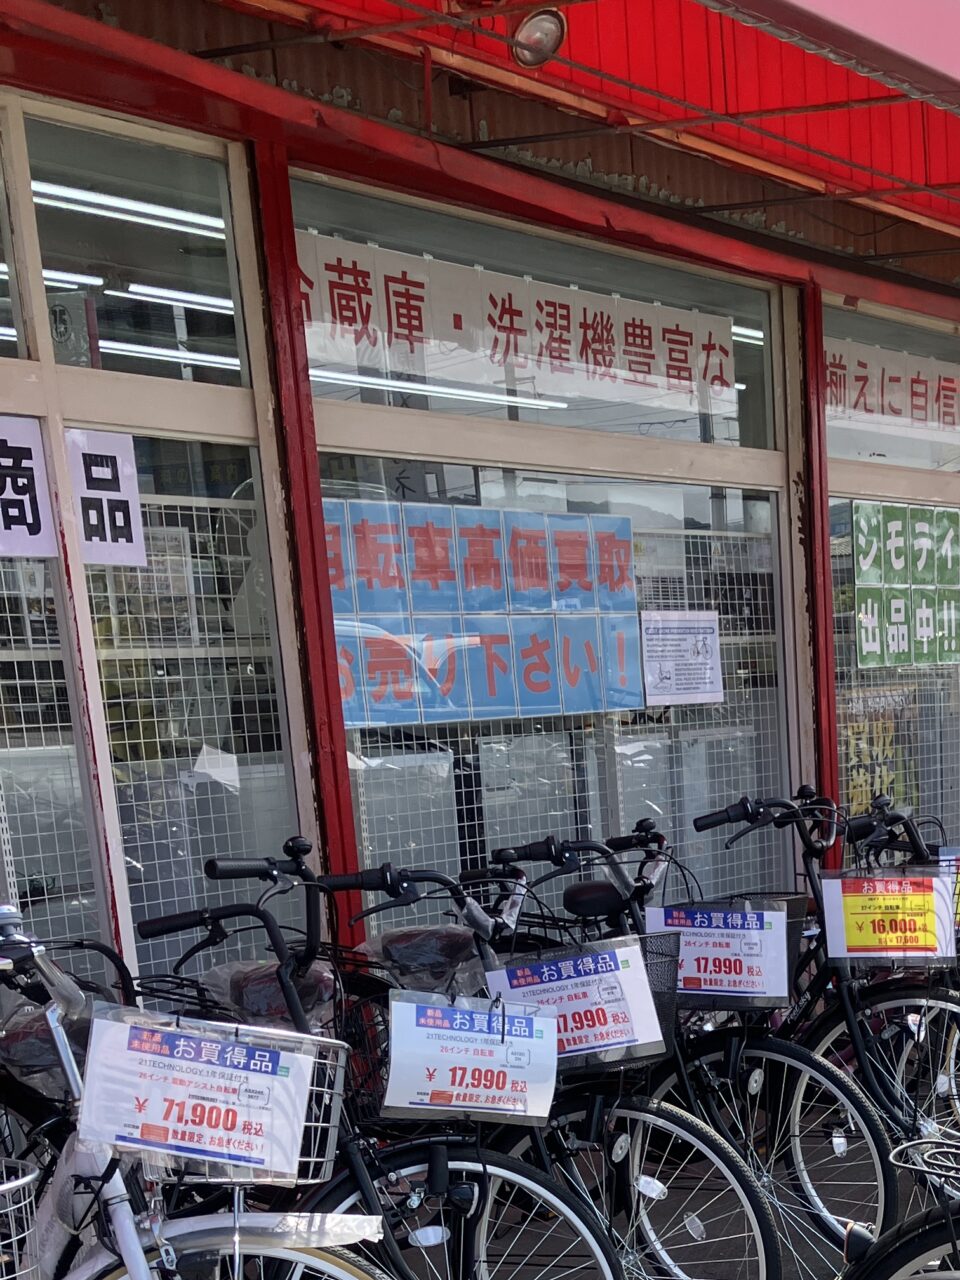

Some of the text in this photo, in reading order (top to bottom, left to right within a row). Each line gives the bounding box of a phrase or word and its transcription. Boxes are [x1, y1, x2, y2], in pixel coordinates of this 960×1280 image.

[862, 881, 913, 894] お買得品
[694, 912, 760, 929] お買得品
[870, 919, 917, 934] 16,000
[895, 935, 919, 944] 17,600
[541, 954, 616, 983] お買得品
[694, 957, 743, 976] 17,990
[747, 966, 763, 977] 税込
[567, 991, 589, 1001] 自転車
[453, 1012, 529, 1037] お買得品
[611, 1011, 630, 1024] 税込
[130, 1037, 273, 1073] 未使用品 お買得品
[440, 1045, 495, 1058] 26インチ 自転車
[138, 1058, 203, 1076] 21TECHNOLOGY
[138, 1072, 169, 1082] 26インチ
[426, 1066, 528, 1093] ¥ 17,990 税込
[134, 1096, 149, 1113] ¥
[162, 1098, 238, 1132] 71,900
[242, 1120, 264, 1137] 税込
